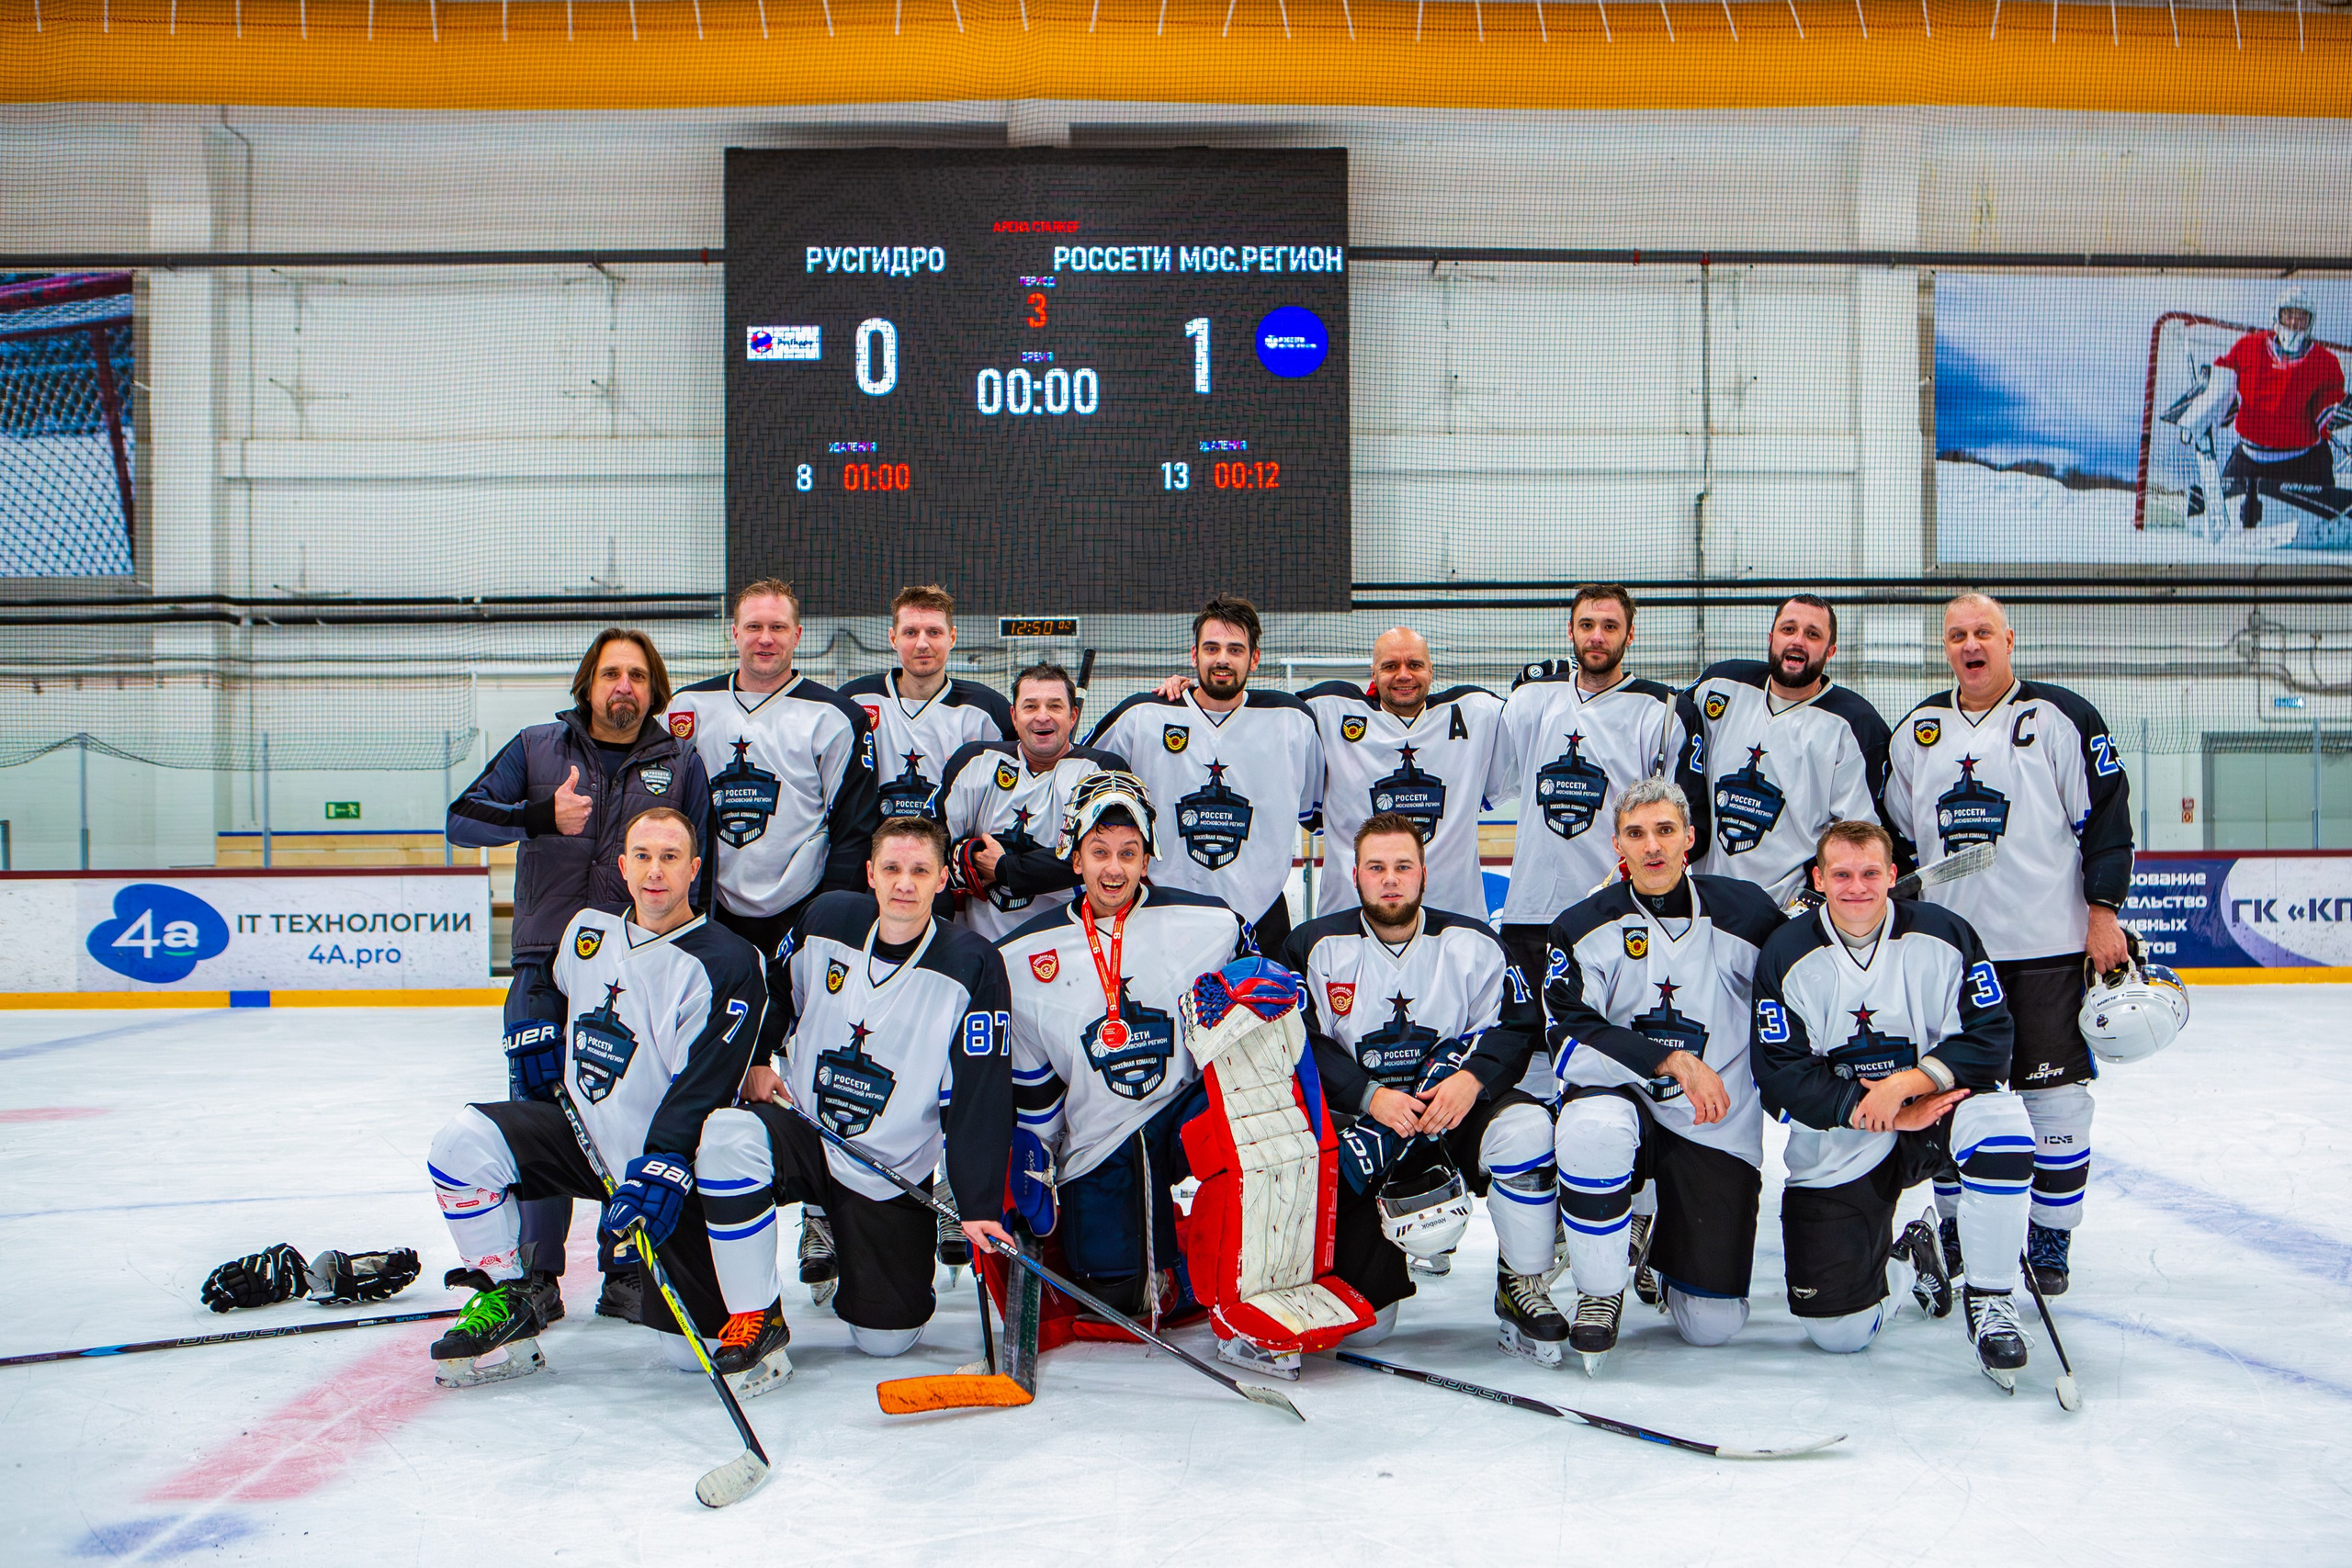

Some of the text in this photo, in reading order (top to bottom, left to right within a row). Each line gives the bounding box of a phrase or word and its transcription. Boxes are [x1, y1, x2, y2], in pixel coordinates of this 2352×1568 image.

[806, 246, 946, 276] РУСГИДРО
[1053, 245, 1343, 273] РОССЕТИ МОС.РЕГИОН
[1026, 292, 1047, 328] 3
[854, 318, 899, 396] 0
[1184, 318, 1212, 395] 1
[977, 367, 1100, 416] 00:00
[796, 463, 814, 492] 8
[843, 463, 910, 491] 01:00
[1160, 461, 1190, 491] 13
[1214, 461, 1280, 489] 00:12
[1011, 620, 1071, 636] 12:50 02
[1448, 704, 1468, 740] A
[2011, 707, 2037, 747] C
[725, 788, 758, 797] РОССЕТИ
[1395, 794, 1428, 802] РОССЕТИ
[1555, 781, 1587, 790] РОССЕТИ
[895, 800, 924, 808] РОССЕТ
[1730, 794, 1761, 808] РОССЕТИ
[1953, 808, 1986, 817] РОССЕТИ
[1200, 811, 1232, 820] РОССЕТИ
[238, 913, 471, 934] IT ТЕХНОЛОГИИ
[2232, 898, 2278, 923] ГК
[111, 908, 199, 959] 4a
[308, 944, 401, 970] 4A.pro
[722, 999, 750, 1044] 7
[962, 1010, 1012, 1056] 87
[502, 1025, 556, 1053] AUER
[587, 1035, 614, 1053] РОССЕТИ
[1130, 1031, 1150, 1042] СЕТИ
[1384, 1048, 1420, 1060] РОССЕТИ
[1854, 1059, 1895, 1072] РОССЕТИ
[833, 1074, 871, 1091] РОССЕТИ
[565, 1108, 590, 1146] CCM
[641, 1160, 694, 1195] BAU
[1420, 1217, 1447, 1230] Reebok
[394, 1313, 430, 1324] NEXUS
